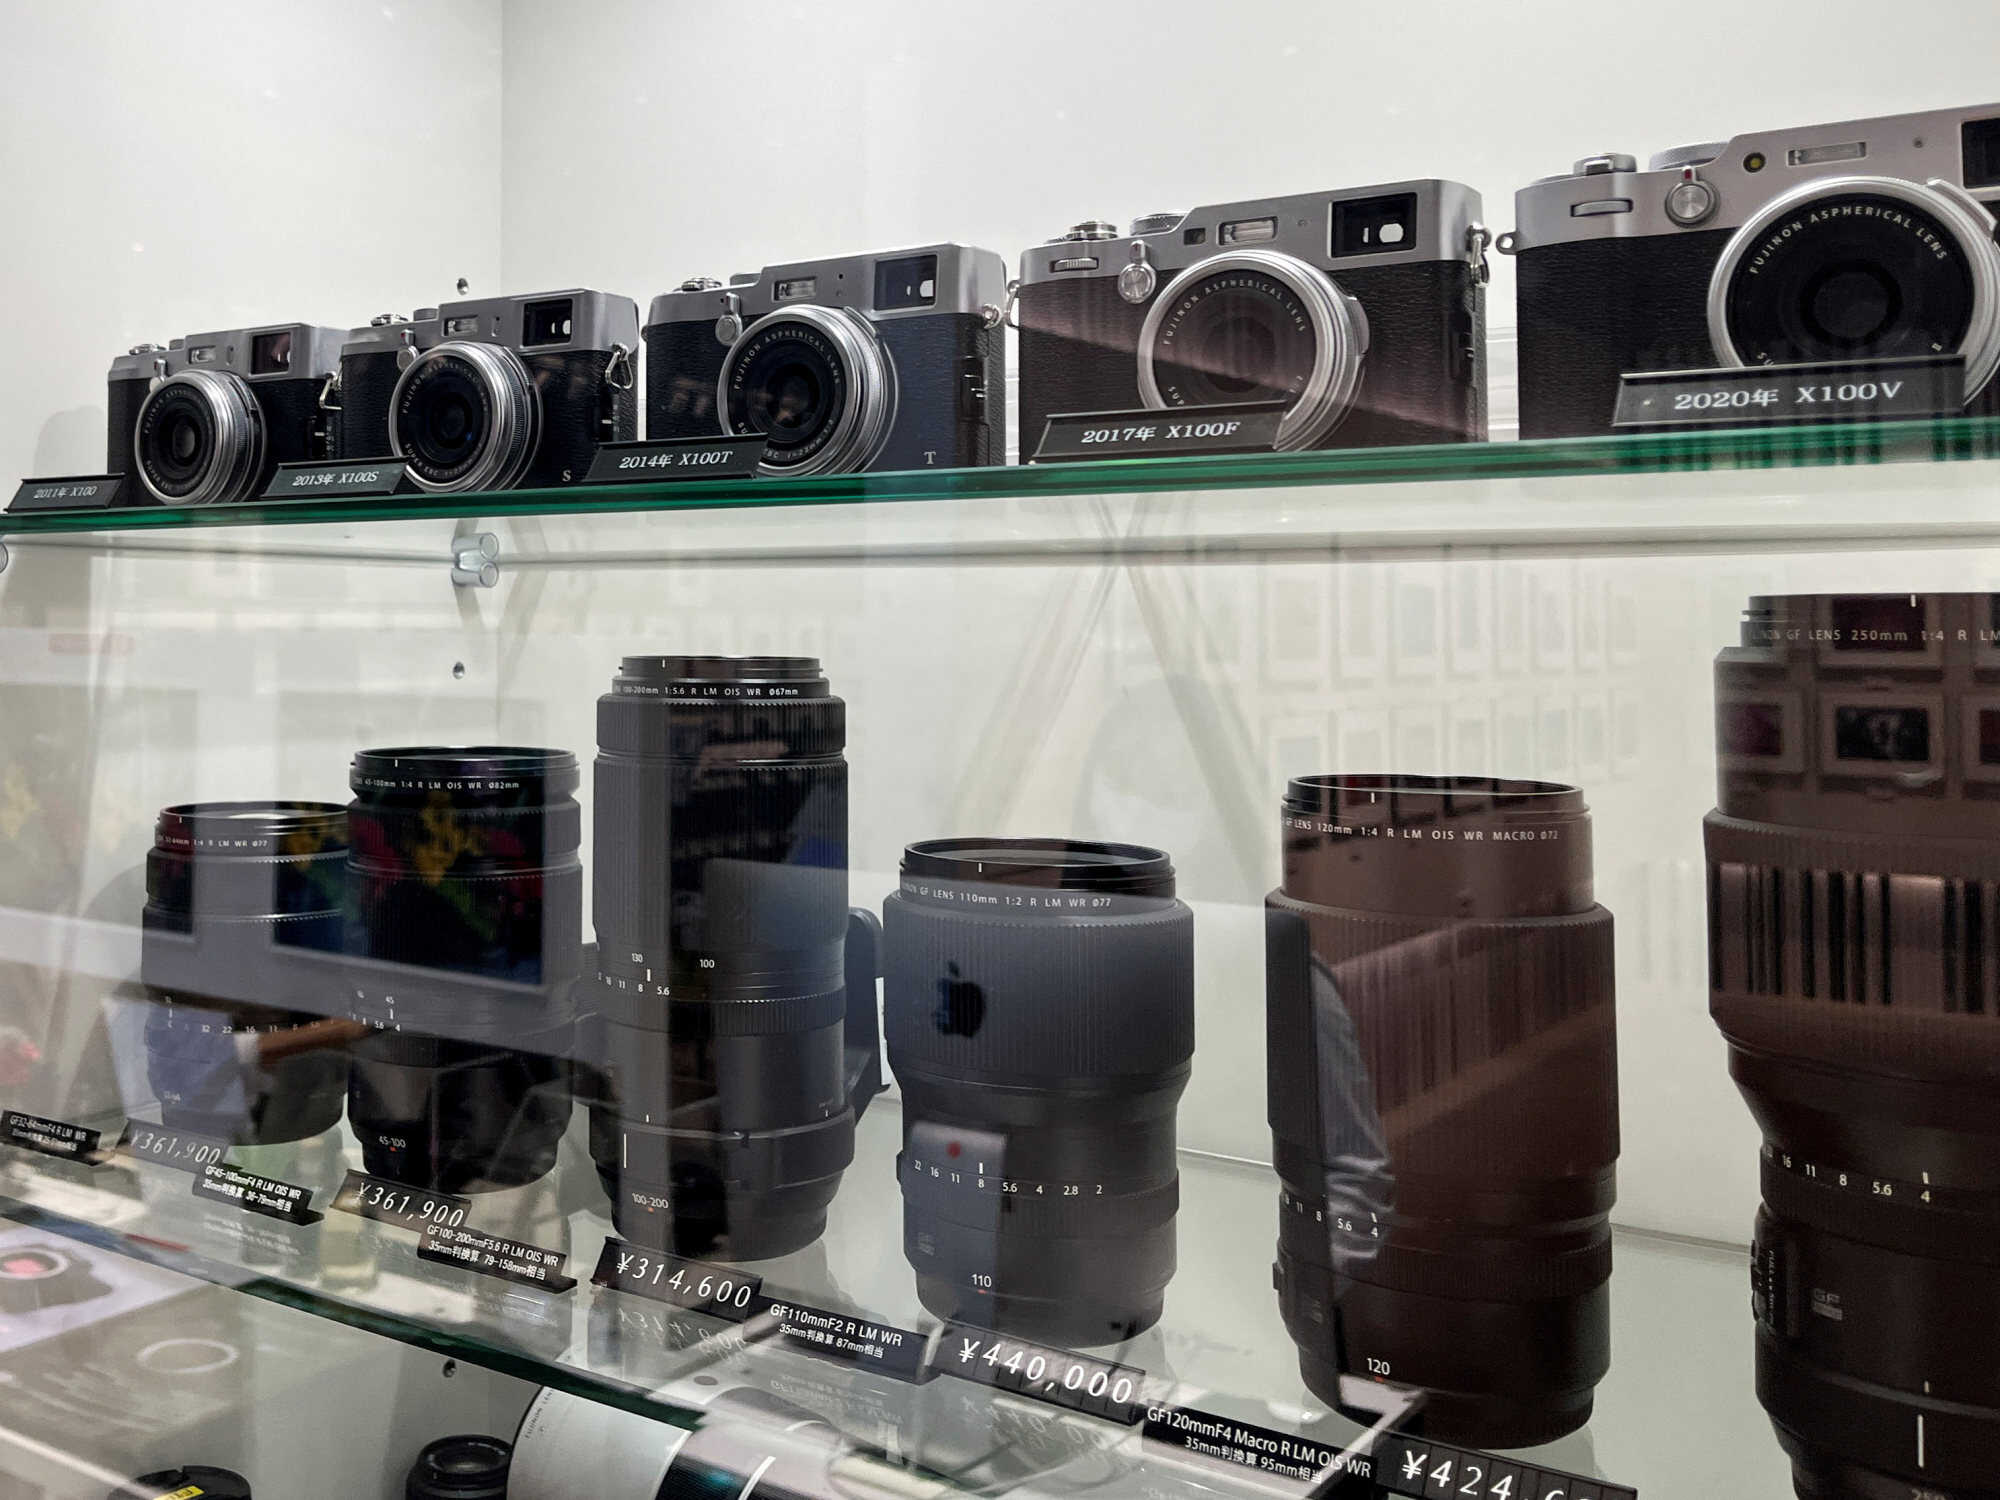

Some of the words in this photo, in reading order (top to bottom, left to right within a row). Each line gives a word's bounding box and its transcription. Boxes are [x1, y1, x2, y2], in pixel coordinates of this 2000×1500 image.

[1750, 222, 1803, 274] FUJINON
[1810, 206, 1911, 229] ASPHERICAL
[1916, 227, 1948, 260] LENS
[1163, 295, 1199, 345] FUJINON
[1205, 279, 1282, 300] ASPHERICAL
[734, 343, 761, 390] FUJINON
[1674, 387, 1778, 410] 2020年
[1795, 380, 1906, 404] X100V
[1081, 425, 1157, 443] 2017年
[1165, 421, 1241, 439] X100F
[619, 453, 673, 469] 2014年
[678, 451, 734, 466] X100T
[923, 451, 937, 465] T
[292, 473, 334, 487] 2013年
[338, 471, 380, 485] X100S
[562, 469, 571, 482] S
[34, 486, 67, 499] 2011年
[70, 485, 98, 497] X100
[1808, 629, 1841, 641] LENS
[1851, 629, 1909, 641] 250mm
[1958, 630, 1967, 641] R
[665, 687, 685, 695] 1:5.6
[691, 687, 697, 696] R
[703, 687, 718, 696] LM
[724, 687, 741, 696] OIS
[747, 688, 761, 697] WR
[418, 781, 423, 789] R
[429, 782, 441, 790] LM
[447, 782, 462, 790] OIS
[468, 782, 482, 790] WR
[1294, 819, 1312, 830] LENS
[1317, 822, 1353, 835] 120mm
[1361, 826, 1378, 836] 1:4
[1387, 828, 1394, 838] R
[1403, 828, 1422, 839] LM
[1432, 829, 1454, 840] OIS
[1464, 830, 1484, 841] WR
[1493, 830, 1535, 842] MACRO
[933, 889, 954, 900] LENS
[960, 893, 998, 905] 110mm
[1005, 896, 1022, 906] 1:2
[1030, 898, 1037, 907] R
[1045, 898, 1062, 908] LM
[1068, 898, 1086, 908] WR
[632, 953, 643, 963] 130
[700, 959, 715, 969] 100
[638, 983, 644, 993] 8
[657, 986, 670, 996] 5.6
[130, 1128, 221, 1165] ¥361,900
[379, 1135, 407, 1149] 45-100
[256, 1178, 263, 1189] R
[263, 1180, 275, 1193] LM
[275, 1183, 288, 1196] OIS
[288, 1188, 302, 1200] WR
[930, 1166, 940, 1179] 16
[951, 1172, 961, 1184] 11
[978, 1178, 985, 1189] 8
[1002, 1182, 1018, 1193] 5.6
[1036, 1185, 1043, 1195] 4
[1063, 1185, 1079, 1196] 2.8
[1096, 1184, 1103, 1195] 2
[1806, 1163, 1817, 1179] 11
[1839, 1174, 1848, 1187] 8
[1872, 1181, 1893, 1197] 5.6
[1921, 1190, 1931, 1204] 4
[352, 1181, 464, 1228] ¥361,900
[631, 1192, 669, 1210] 100-200
[1316, 1210, 1322, 1222] 8
[1337, 1217, 1352, 1232] 5.6
[1371, 1227, 1378, 1238] 4
[426, 1223, 501, 1252] GF100-200mmF5.6
[502, 1242, 511, 1254] R
[511, 1243, 525, 1259] LM
[526, 1248, 542, 1263] OIS
[542, 1253, 559, 1268] WR
[616, 1251, 751, 1309] ¥314,600
[972, 1273, 992, 1289] 110
[770, 1302, 844, 1333] GF110mmF2
[845, 1321, 857, 1336] R
[858, 1324, 878, 1342] LM
[881, 1330, 903, 1348] WR
[835, 1336, 885, 1360] 87mm相当
[958, 1337, 1133, 1405] ¥440,000
[1367, 1357, 1391, 1376] 120
[1147, 1405, 1232, 1441] GF120mmF4
[1234, 1427, 1278, 1454] Macro
[1281, 1441, 1292, 1458] R
[1293, 1443, 1316, 1464] LM
[1318, 1449, 1343, 1471] OIS
[1346, 1456, 1372, 1478] WR
[1185, 1434, 1259, 1467] 35mm判換算
[1260, 1455, 1323, 1484] 95mm相当
